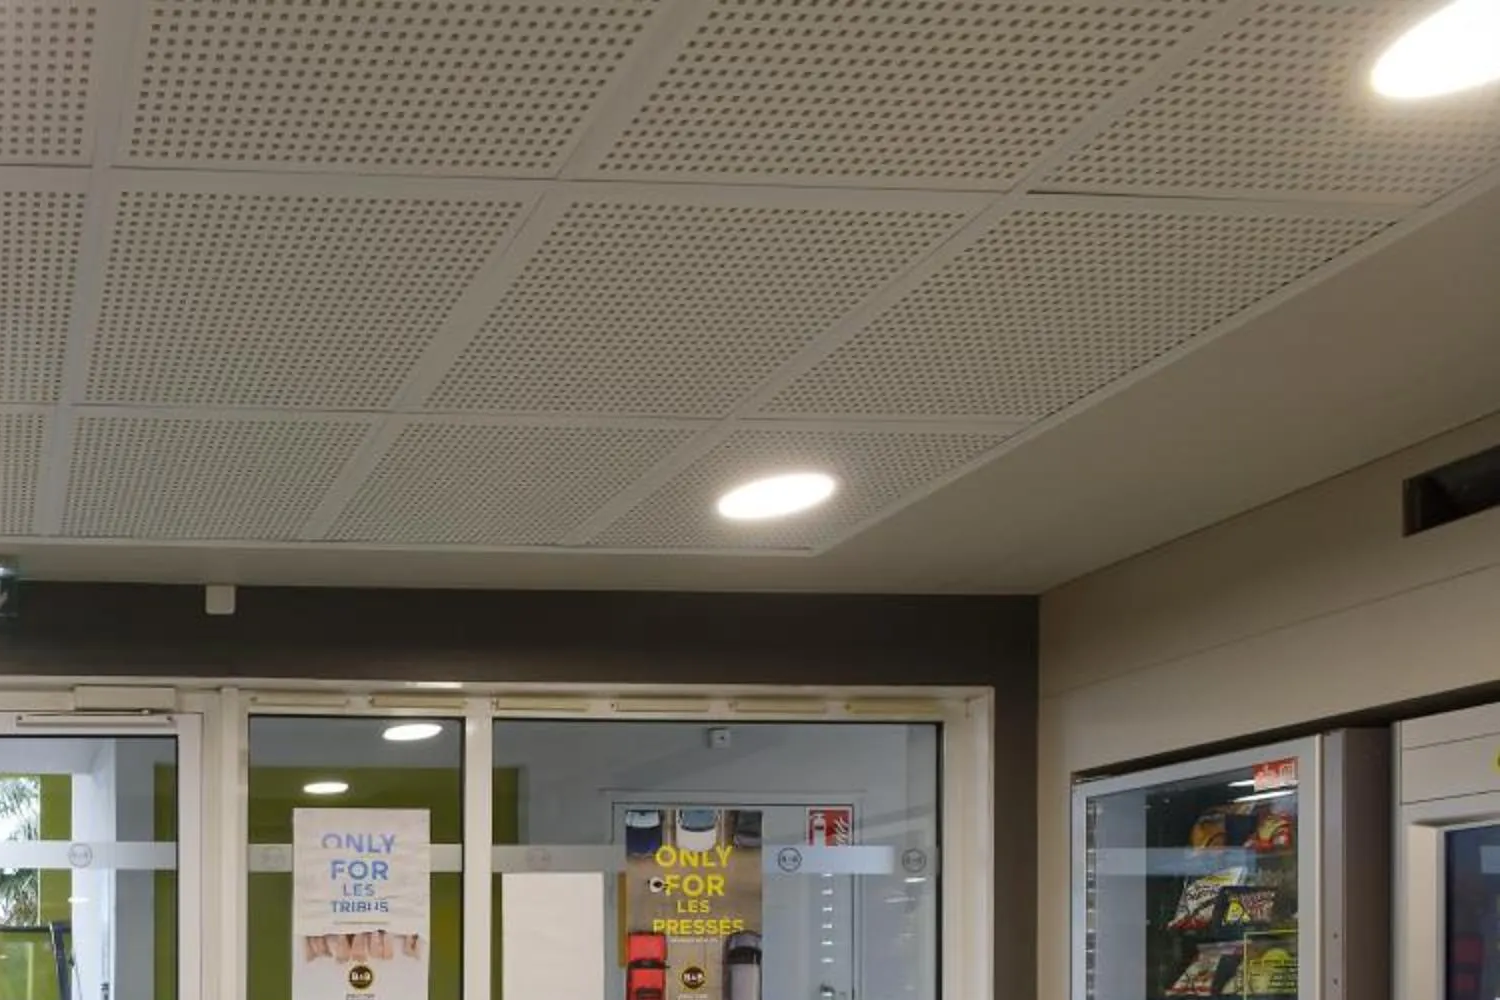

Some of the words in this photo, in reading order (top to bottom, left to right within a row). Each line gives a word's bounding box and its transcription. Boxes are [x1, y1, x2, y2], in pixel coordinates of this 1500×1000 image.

[322, 833, 395, 853] ONLY
[655, 845, 733, 868] ONLY
[330, 860, 390, 881] FOR
[342, 883, 376, 897] LES
[664, 874, 725, 897] FOR
[676, 900, 710, 914] LES
